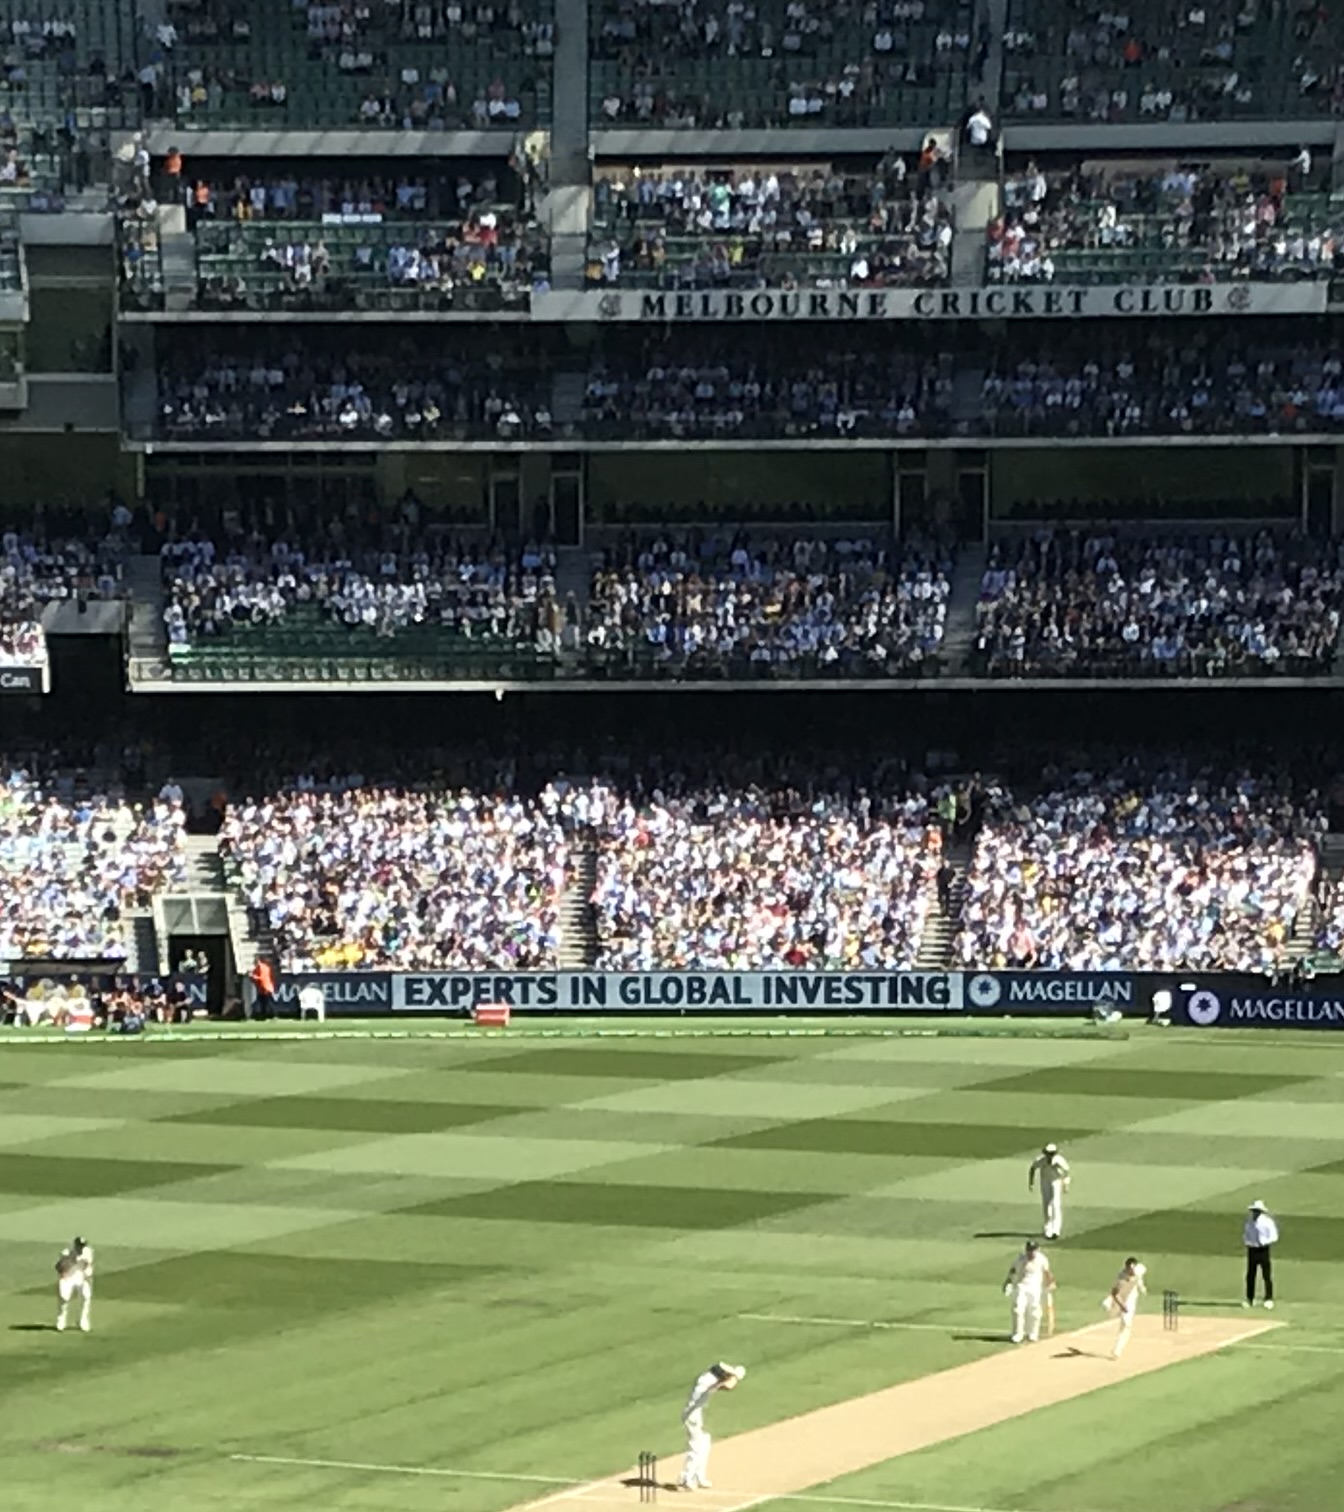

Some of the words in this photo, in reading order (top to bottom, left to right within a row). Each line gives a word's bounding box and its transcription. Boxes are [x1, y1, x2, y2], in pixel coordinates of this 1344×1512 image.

[641, 293, 887, 318] MELBOURNE
[913, 289, 1088, 316] CRICKET
[1113, 288, 1213, 313] CLUB
[0, 673, 31, 688] Can
[272, 982, 387, 1002] MAELLAN
[405, 976, 558, 1005] EXPERTS
[570, 976, 606, 1005] IN
[619, 976, 752, 1006] GLOBAL
[762, 976, 951, 1005] INVESTING
[1009, 980, 1131, 1001] MAGELLAN
